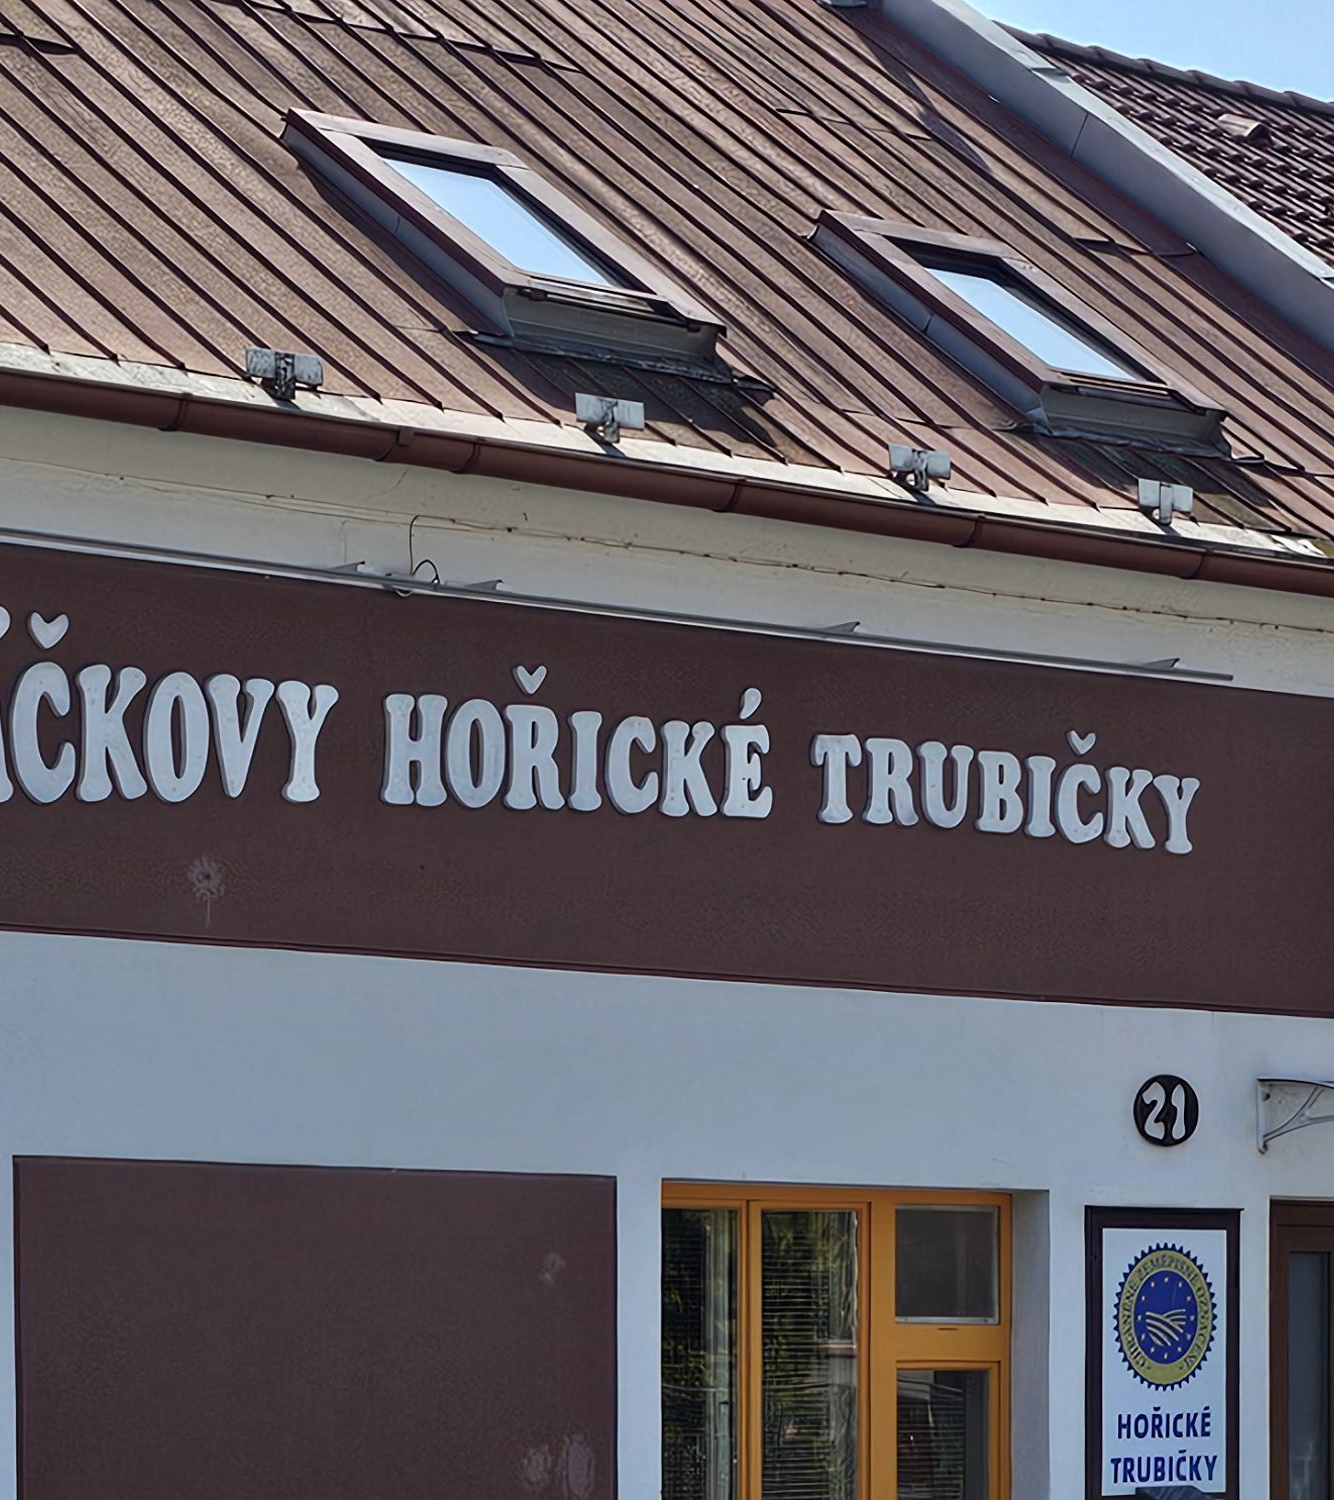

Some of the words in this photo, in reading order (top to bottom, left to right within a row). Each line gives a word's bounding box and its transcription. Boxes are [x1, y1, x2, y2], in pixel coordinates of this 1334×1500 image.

[381, 664, 773, 820] HOŘICKÉ
[811, 730, 1201, 855] TRUBIČKY
[1142, 1081, 1186, 1139] 21
[1117, 1405, 1211, 1439] HOŘICKÉ
[1110, 1449, 1218, 1484] TRUBIČKY
